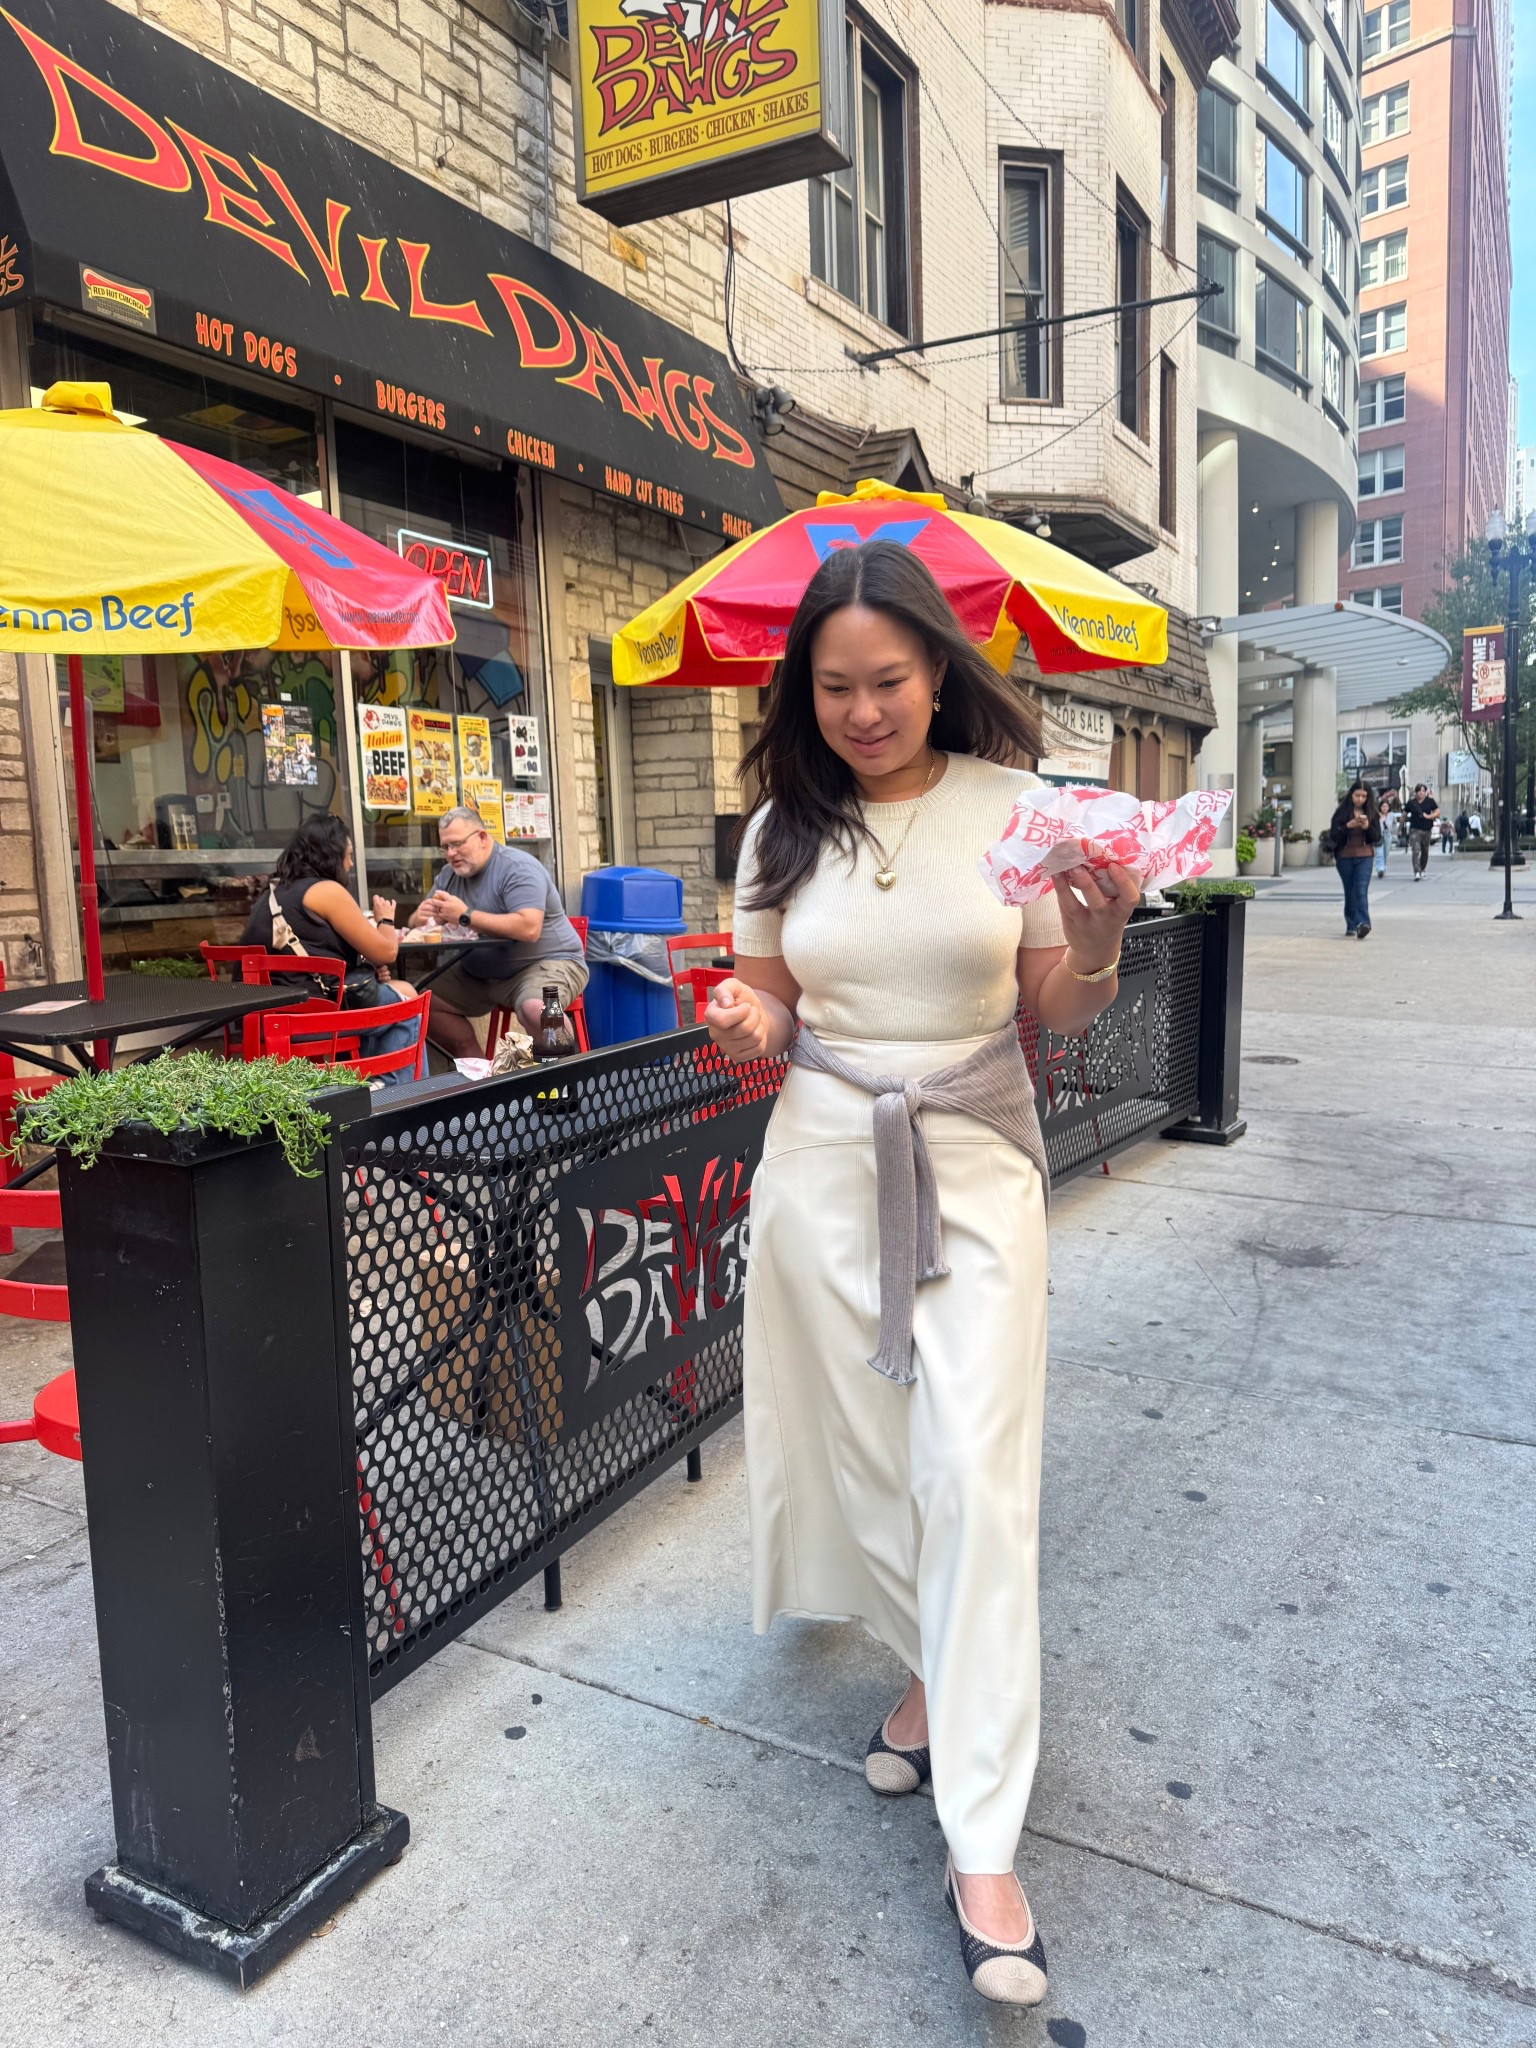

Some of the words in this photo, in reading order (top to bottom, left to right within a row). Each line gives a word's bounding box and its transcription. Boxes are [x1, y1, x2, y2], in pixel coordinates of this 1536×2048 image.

[589, 0, 788, 83] DEVIL
[597, 19, 798, 137] DAWGS
[592, 154, 614, 174] HOT
[616, 143, 643, 165] DOGS
[649, 126, 700, 156] BURGERS
[706, 108, 756, 139] CHICKEN
[763, 91, 809, 123] SHAKES
[0, 8, 493, 337] DEVIL
[93, 286, 105, 296] RED
[106, 288, 117, 299] HOT
[118, 292, 144, 311] CHICAGO
[486, 273, 756, 468] DAWGS
[195, 311, 233, 356] HOT
[244, 331, 298, 378] DOGS
[375, 379, 446, 430] BURGERS
[507, 428, 555, 469] CHICKEN
[605, 465, 631, 496] HAND
[636, 478, 653, 503] CUT
[656, 486, 684, 516] FRIES
[722, 513, 752, 539] SHAKES
[404, 541, 485, 600] OPEN
[101, 591, 195, 637] Beef
[1053, 604, 1105, 640] Vienna
[1106, 613, 1139, 652] Beef
[367, 732, 402, 748] Italian
[382, 719, 402, 727] DAWGS
[1056, 705, 1076, 729] FOR
[1080, 711, 1104, 734] SALE
[372, 750, 406, 776] BEEF
[576, 1147, 751, 1299] DEVIL
